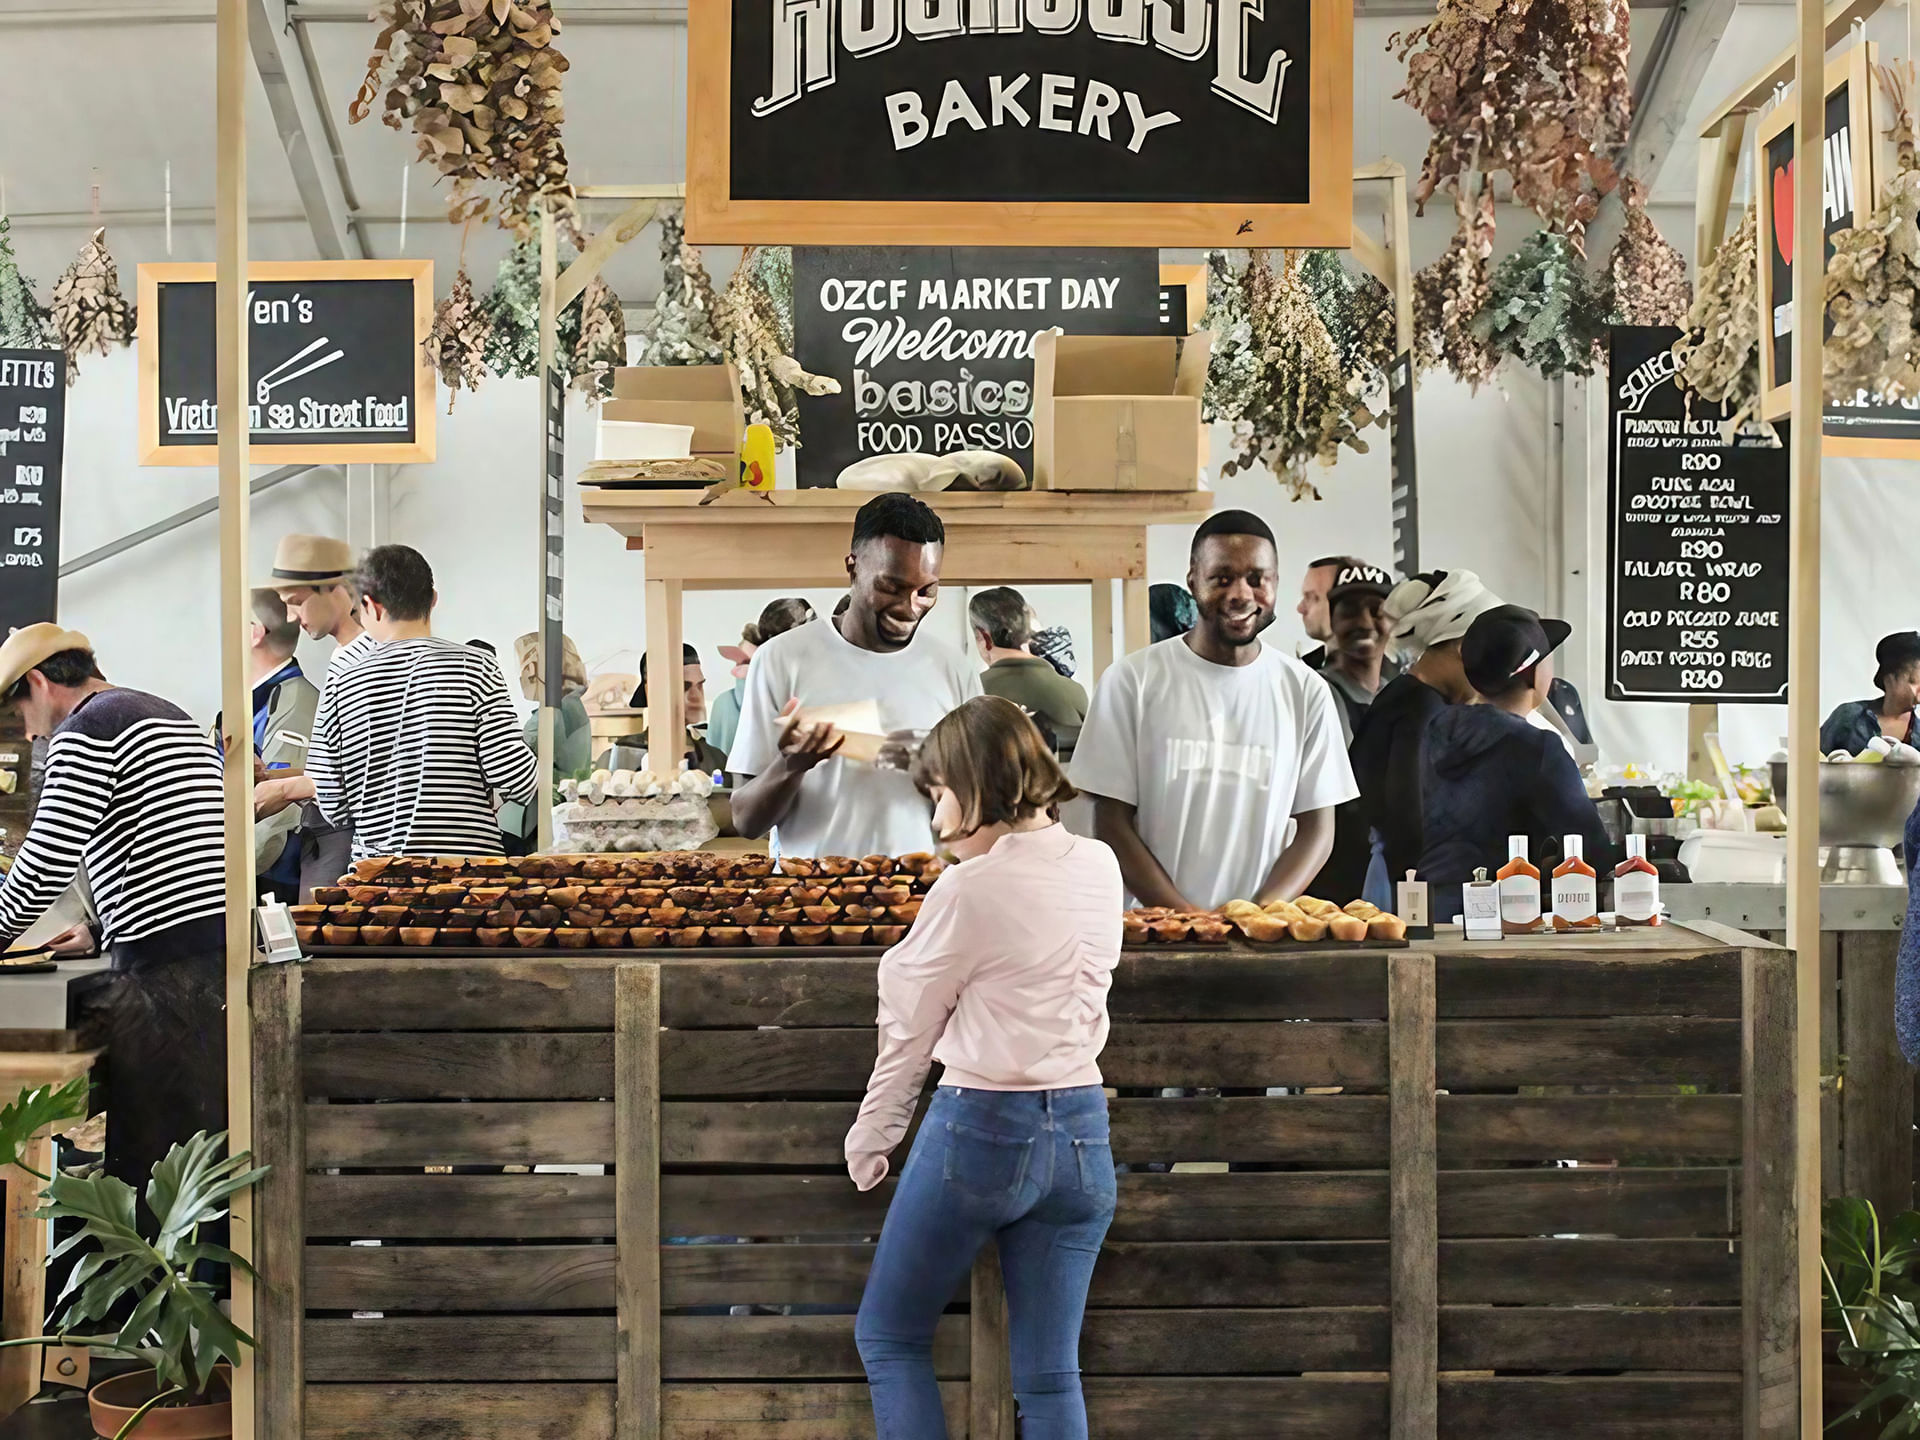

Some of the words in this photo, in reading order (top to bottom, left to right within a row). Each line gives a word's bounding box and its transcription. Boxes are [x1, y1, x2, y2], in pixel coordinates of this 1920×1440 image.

[886, 73, 1181, 153] BAKERY
[820, 279, 908, 312] OZCF
[918, 278, 1053, 311] MARKET
[1061, 278, 1121, 311] DAY
[853, 367, 1031, 418] basics
[299, 397, 362, 428] Street
[365, 395, 408, 427] Food
[857, 421, 923, 453] FOOD
